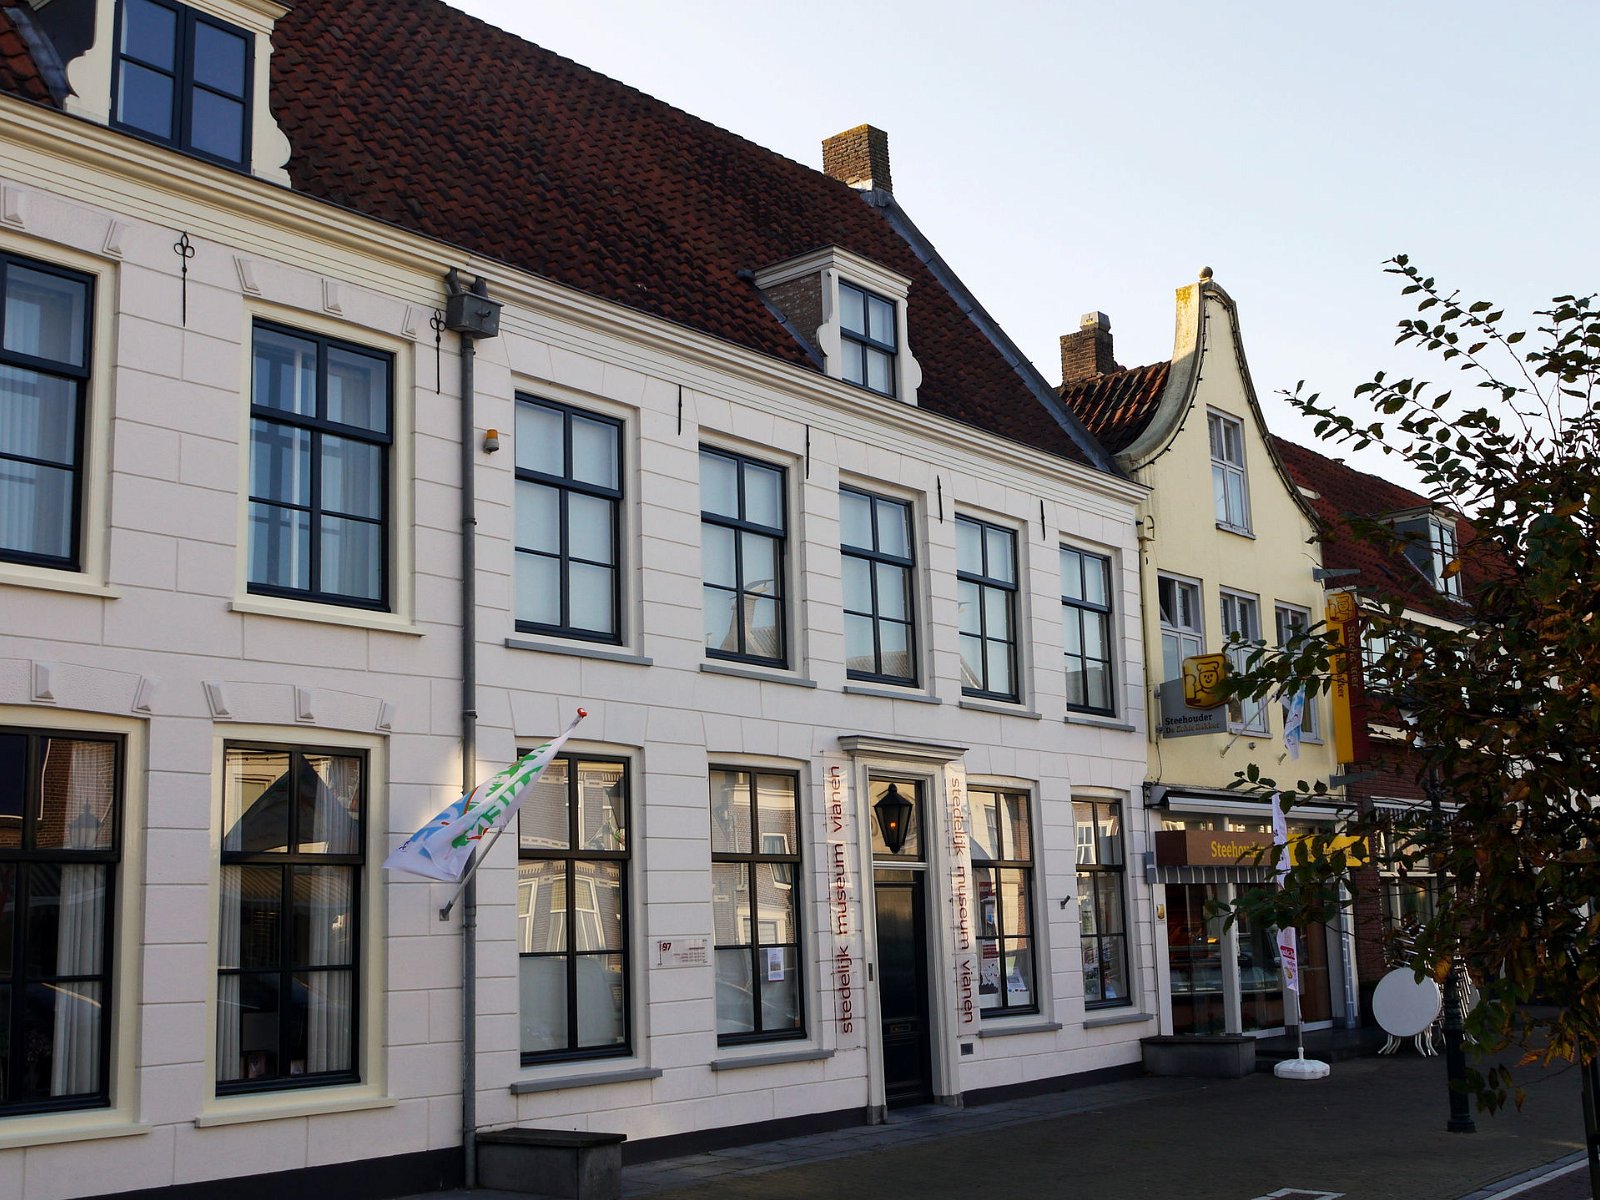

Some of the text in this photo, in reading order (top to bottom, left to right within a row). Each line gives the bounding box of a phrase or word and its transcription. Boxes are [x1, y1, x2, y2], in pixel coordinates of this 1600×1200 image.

[1165, 713, 1213, 725] Steehouder
[662, 942, 672, 951] 97
[830, 766, 853, 1033] stedelijk museum vianen
[952, 778, 974, 1023] stedelijk museum vianen
